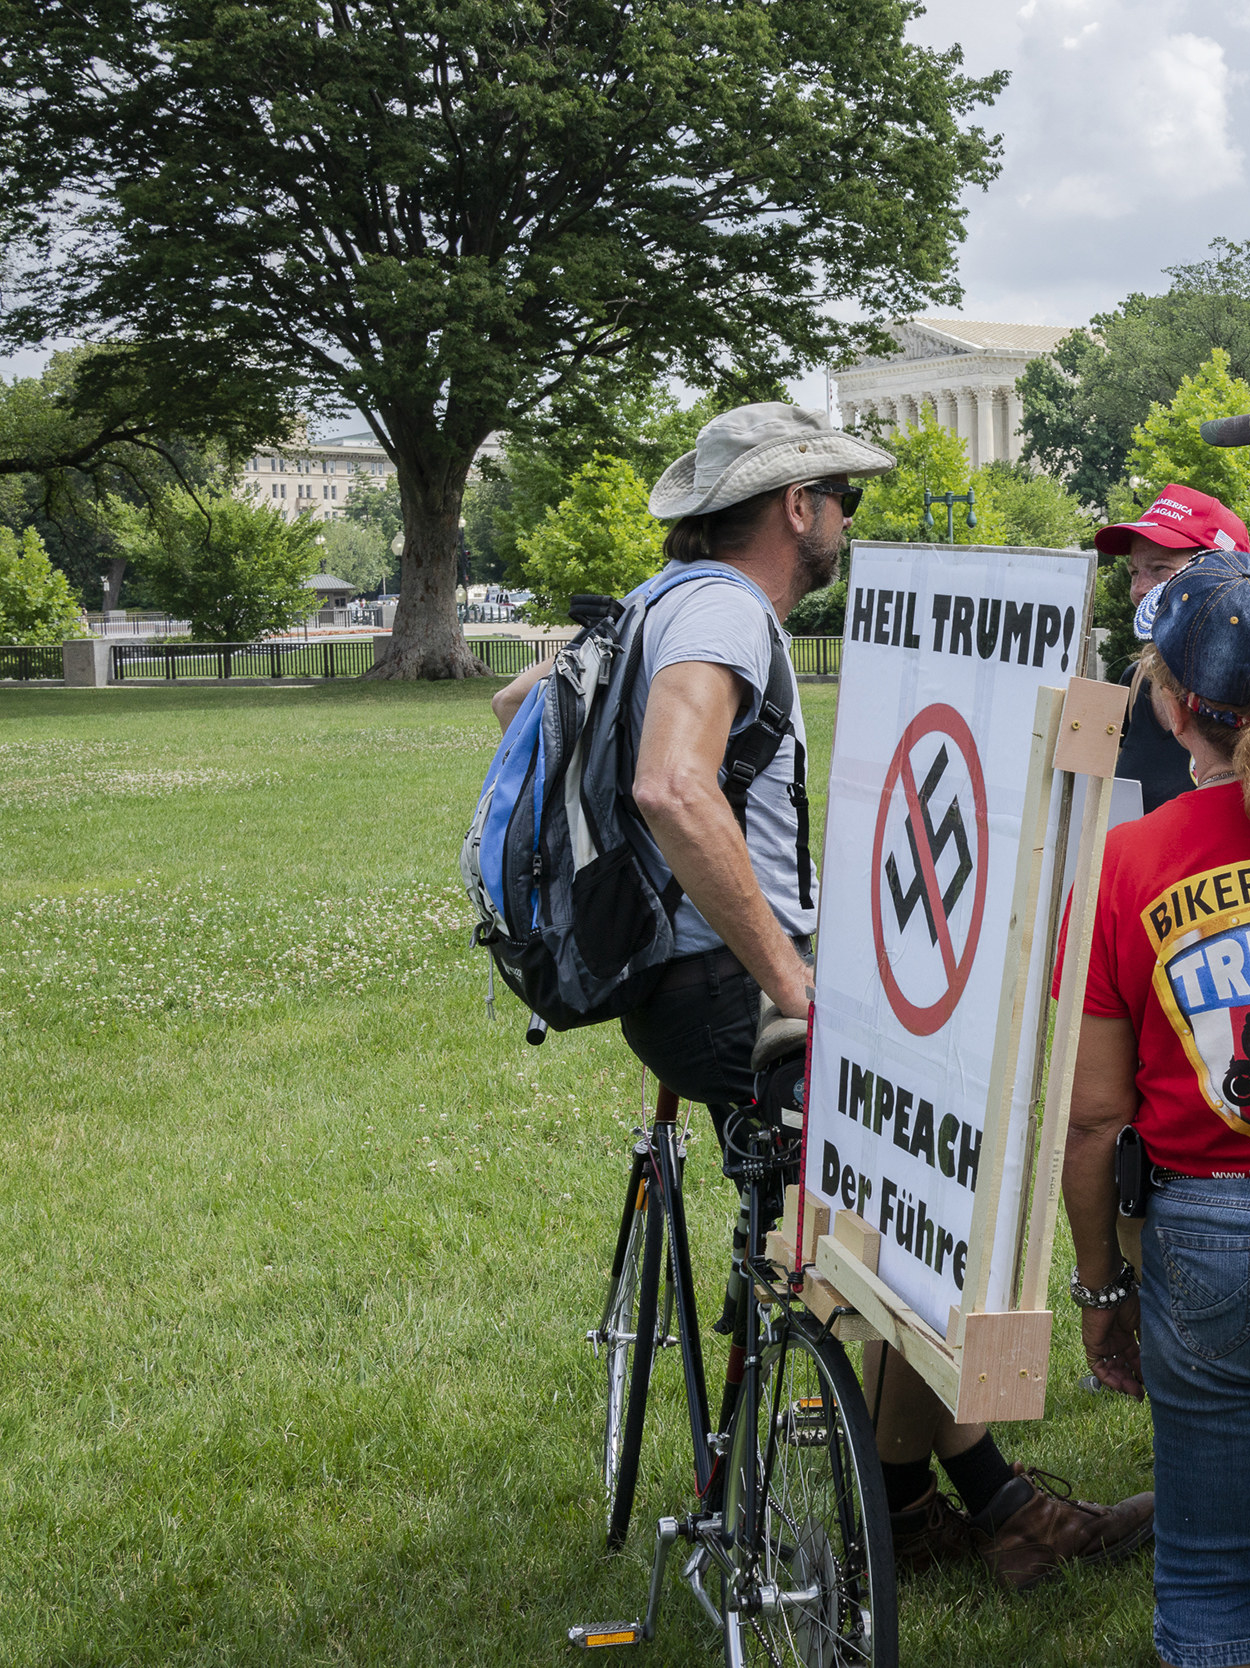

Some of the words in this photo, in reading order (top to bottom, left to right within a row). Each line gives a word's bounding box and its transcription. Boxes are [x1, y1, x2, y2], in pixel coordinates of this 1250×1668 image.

[851, 587, 920, 649] HEIL
[931, 593, 1076, 673] TRUMP!
[838, 1056, 984, 1193] IMPEACH
[821, 1139, 872, 1219] Der
[879, 1176, 969, 1291] Führe
